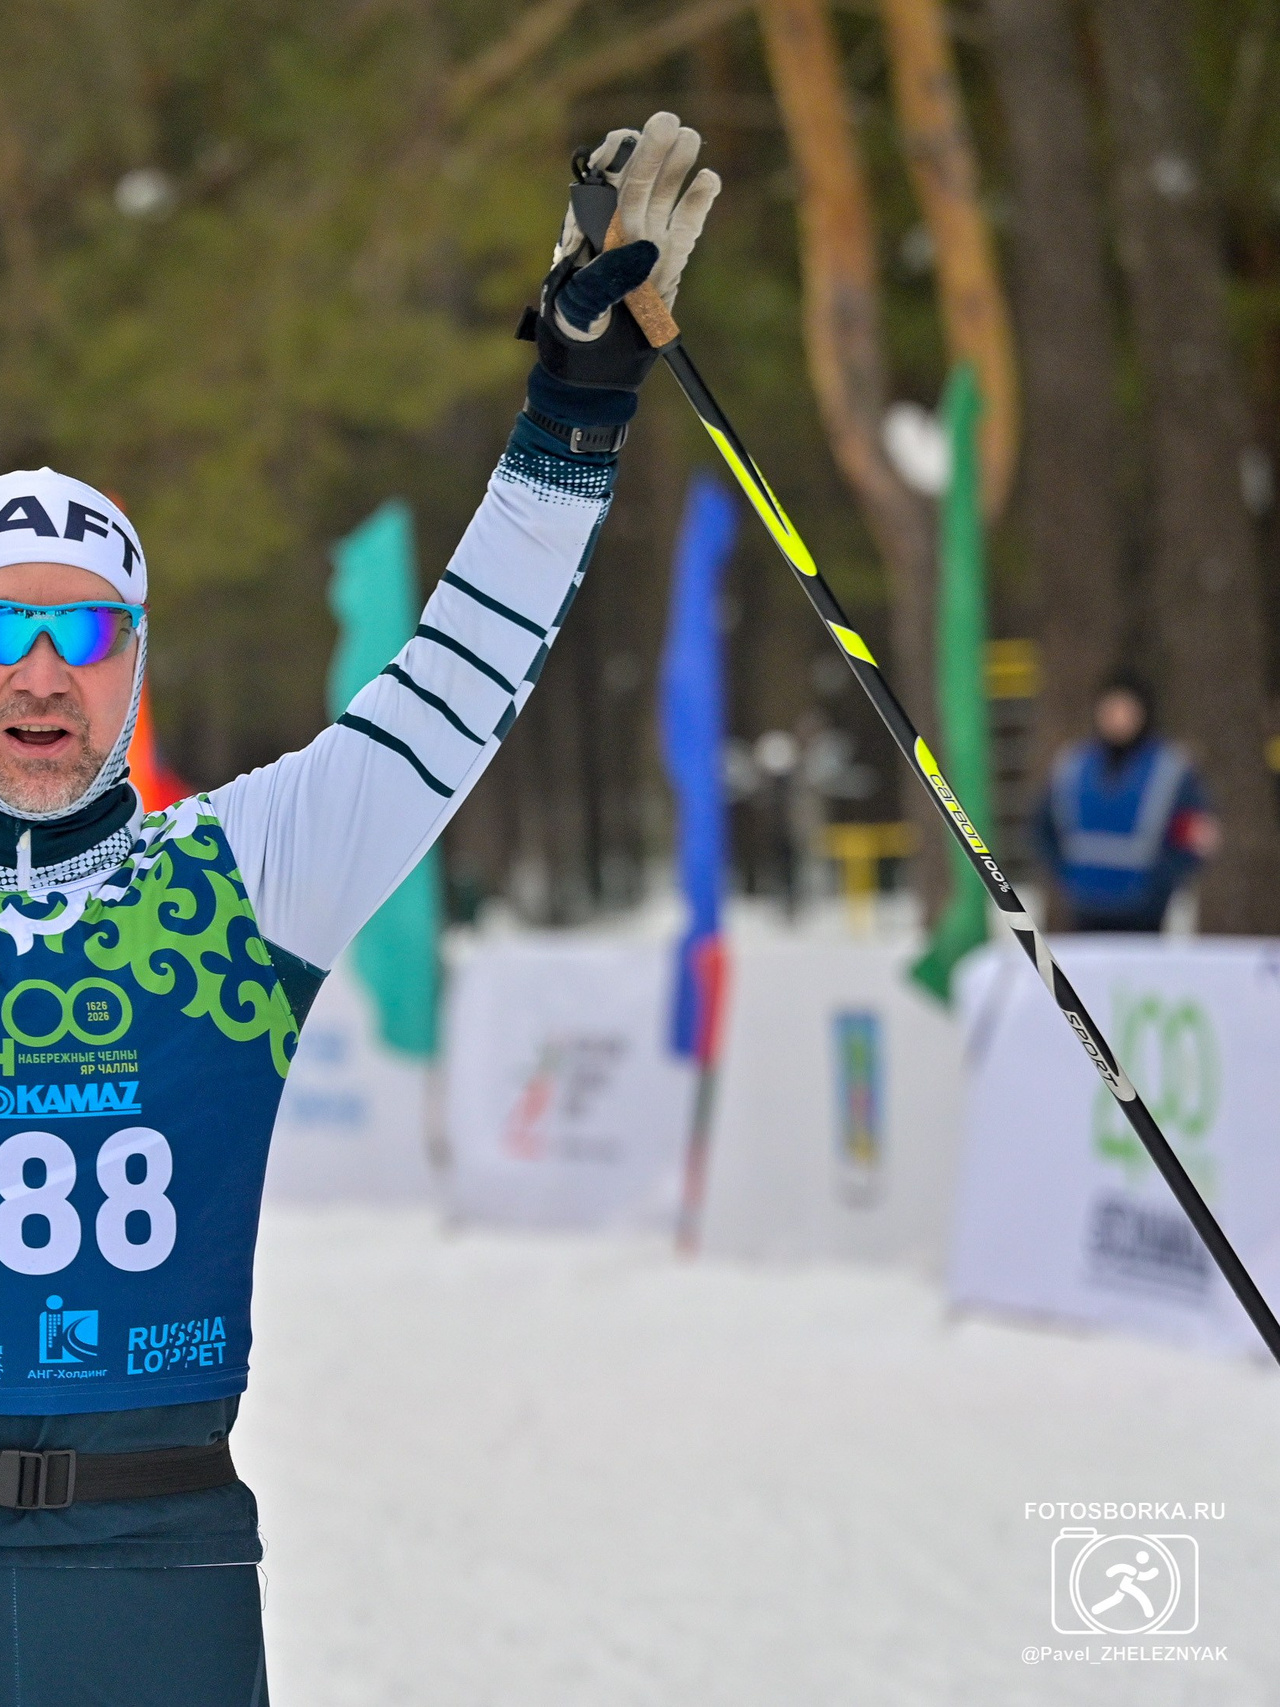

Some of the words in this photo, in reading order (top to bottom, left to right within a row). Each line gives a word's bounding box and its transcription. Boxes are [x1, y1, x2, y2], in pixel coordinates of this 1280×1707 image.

[980, 855, 1010, 893] 100%
[86, 1001, 108, 1011] 1626
[87, 1012, 110, 1022] 2026
[18, 1052, 95, 1064] НАБЕРЕЖНЫЕ
[97, 1049, 137, 1062] ЧЕЛНЫ
[1068, 1012, 1119, 1088] SPORT
[80, 1064, 96, 1075] ЯР
[97, 1062, 138, 1074] ЧАЛЛЫ
[17, 1081, 142, 1114] KAMAZ
[128, 1316, 226, 1351] RUSSIA
[127, 1342, 226, 1375] LOPPET
[27, 1369, 108, 1380] АНГ-Холдинг
